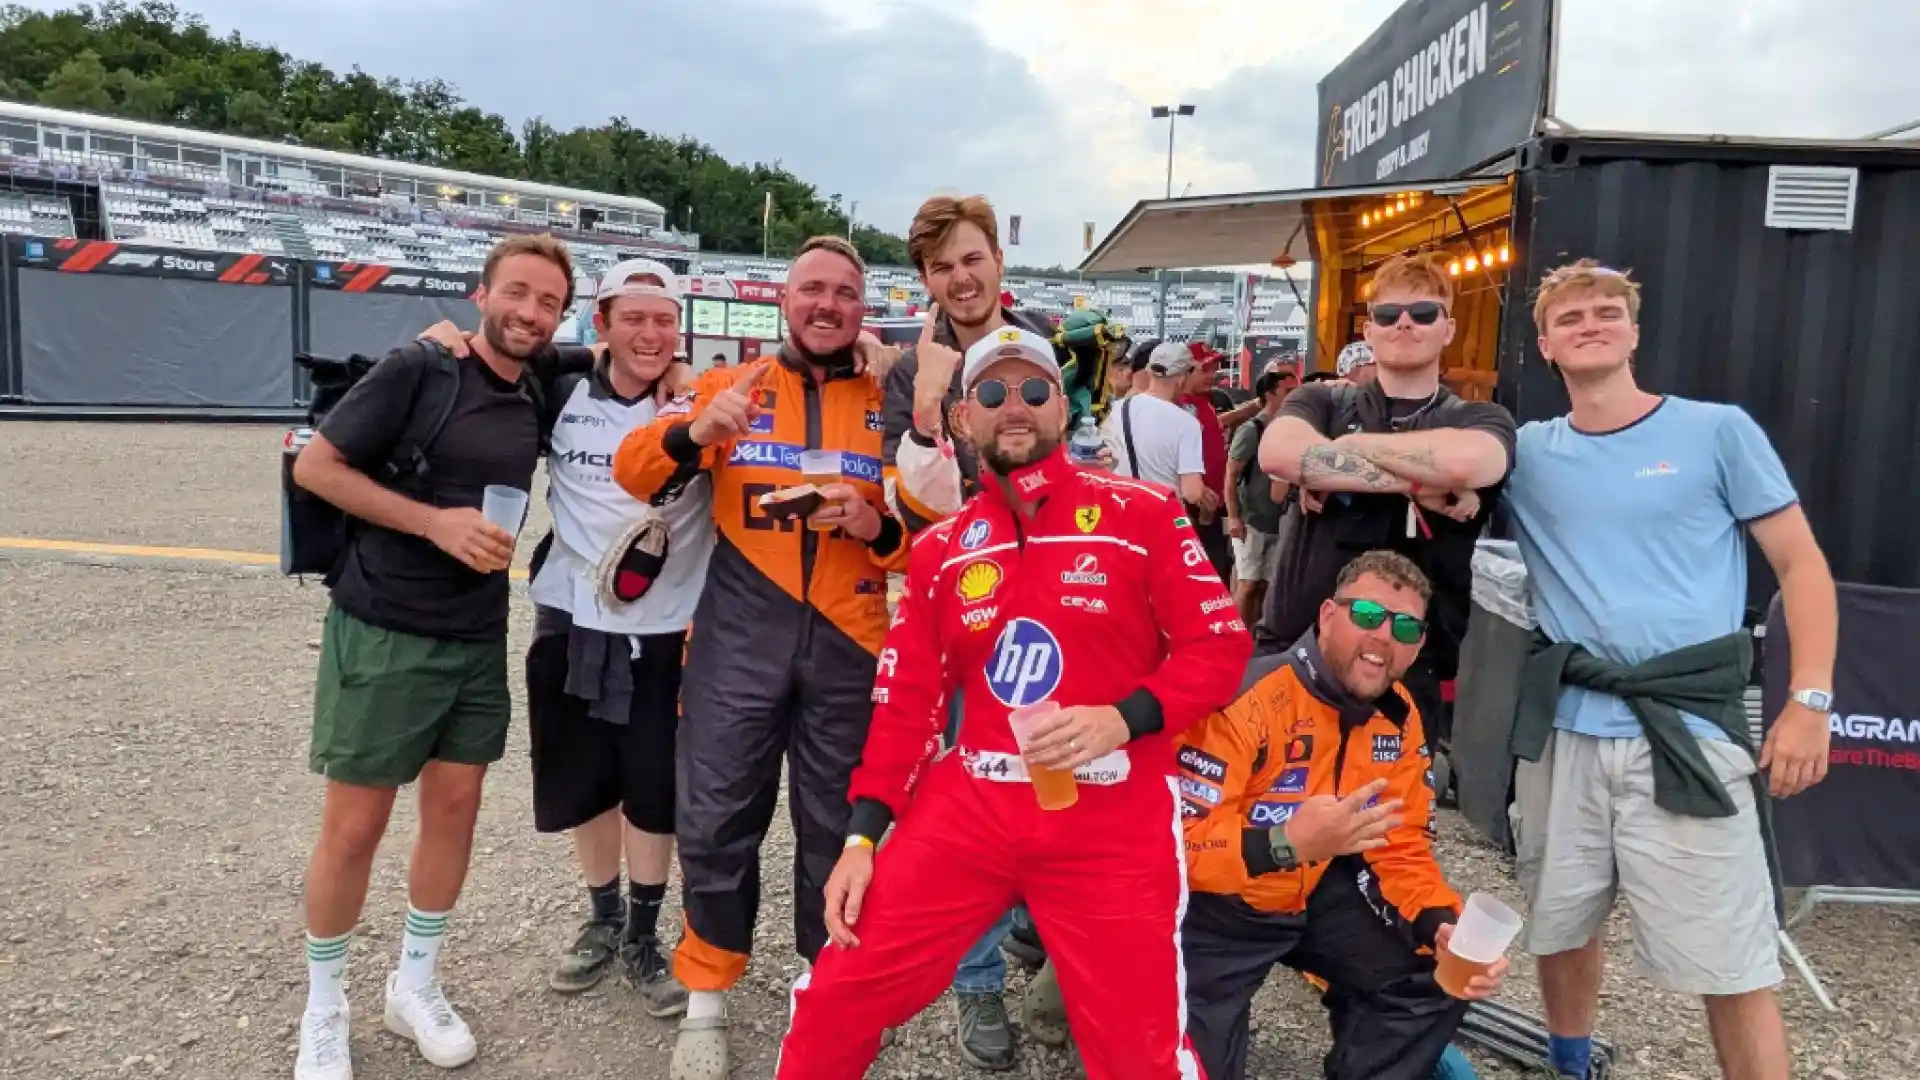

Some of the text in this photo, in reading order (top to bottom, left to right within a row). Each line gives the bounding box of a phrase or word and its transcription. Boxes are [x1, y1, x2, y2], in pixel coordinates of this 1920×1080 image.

[1343, 1, 1488, 161] FRIED CHICKEN
[162, 255, 215, 272] Store
[425, 277, 467, 292] Store
[731, 443, 777, 462] DELL
[579, 473, 611, 483] FORM
[961, 605, 998, 626] VGW
[993, 619, 1052, 704] hp
[1829, 712, 1920, 743] AGRA
[979, 758, 1010, 777] 44
[1073, 769, 1119, 781] MILTON
[1251, 803, 1294, 825] DEL
